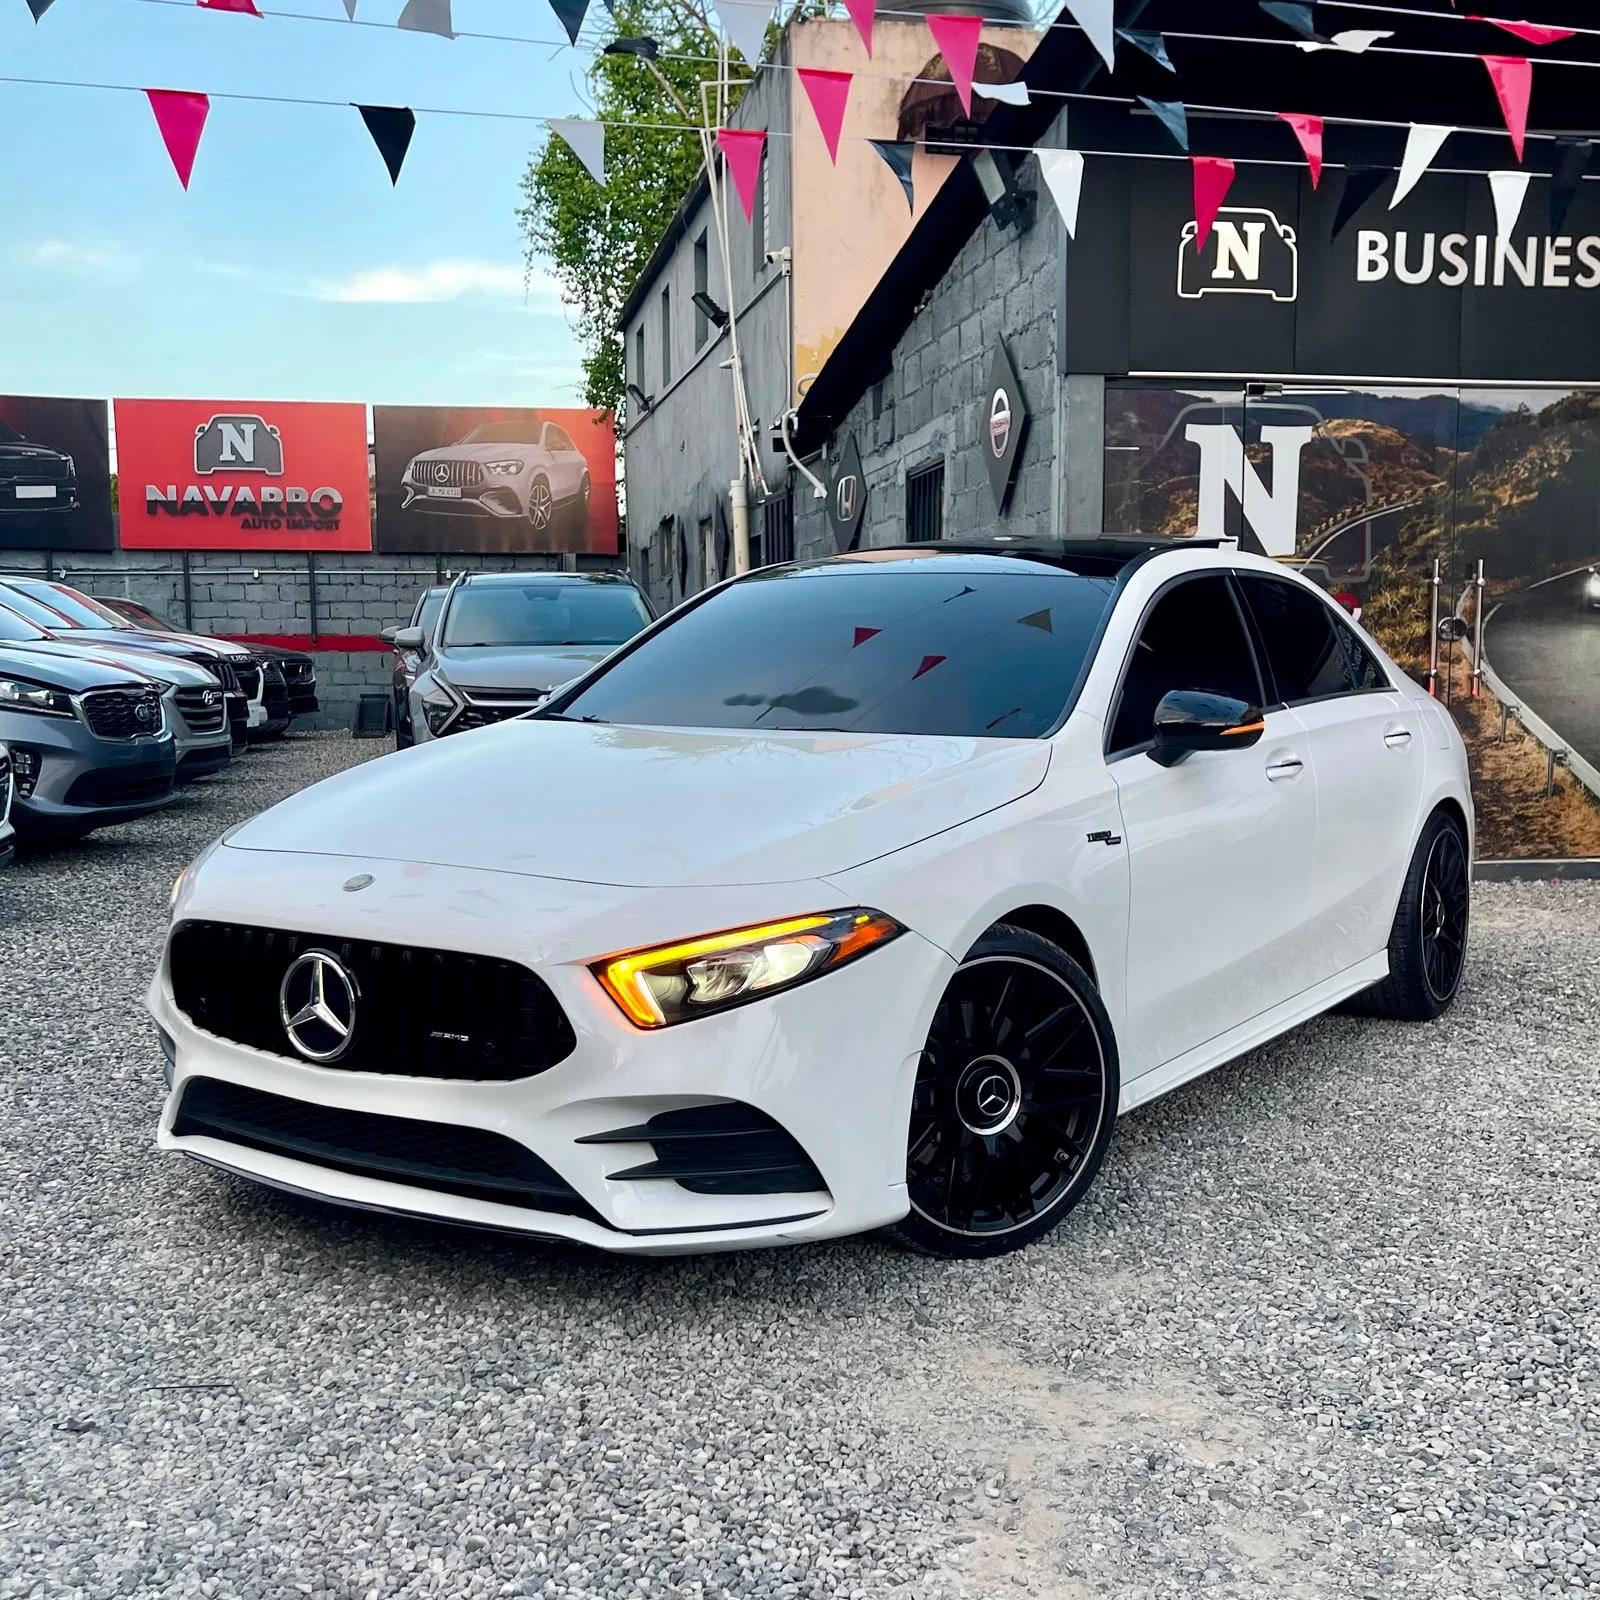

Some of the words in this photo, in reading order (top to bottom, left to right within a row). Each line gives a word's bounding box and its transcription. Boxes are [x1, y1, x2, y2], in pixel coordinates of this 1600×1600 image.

[1211, 221, 1266, 281] N
[1356, 230, 1600, 288] BUSINES
[217, 423, 257, 462] N
[145, 484, 343, 518] NAVARRO
[1184, 423, 1313, 557] N
[241, 518, 282, 530] AUTO
[286, 518, 341, 531] IMPORT
